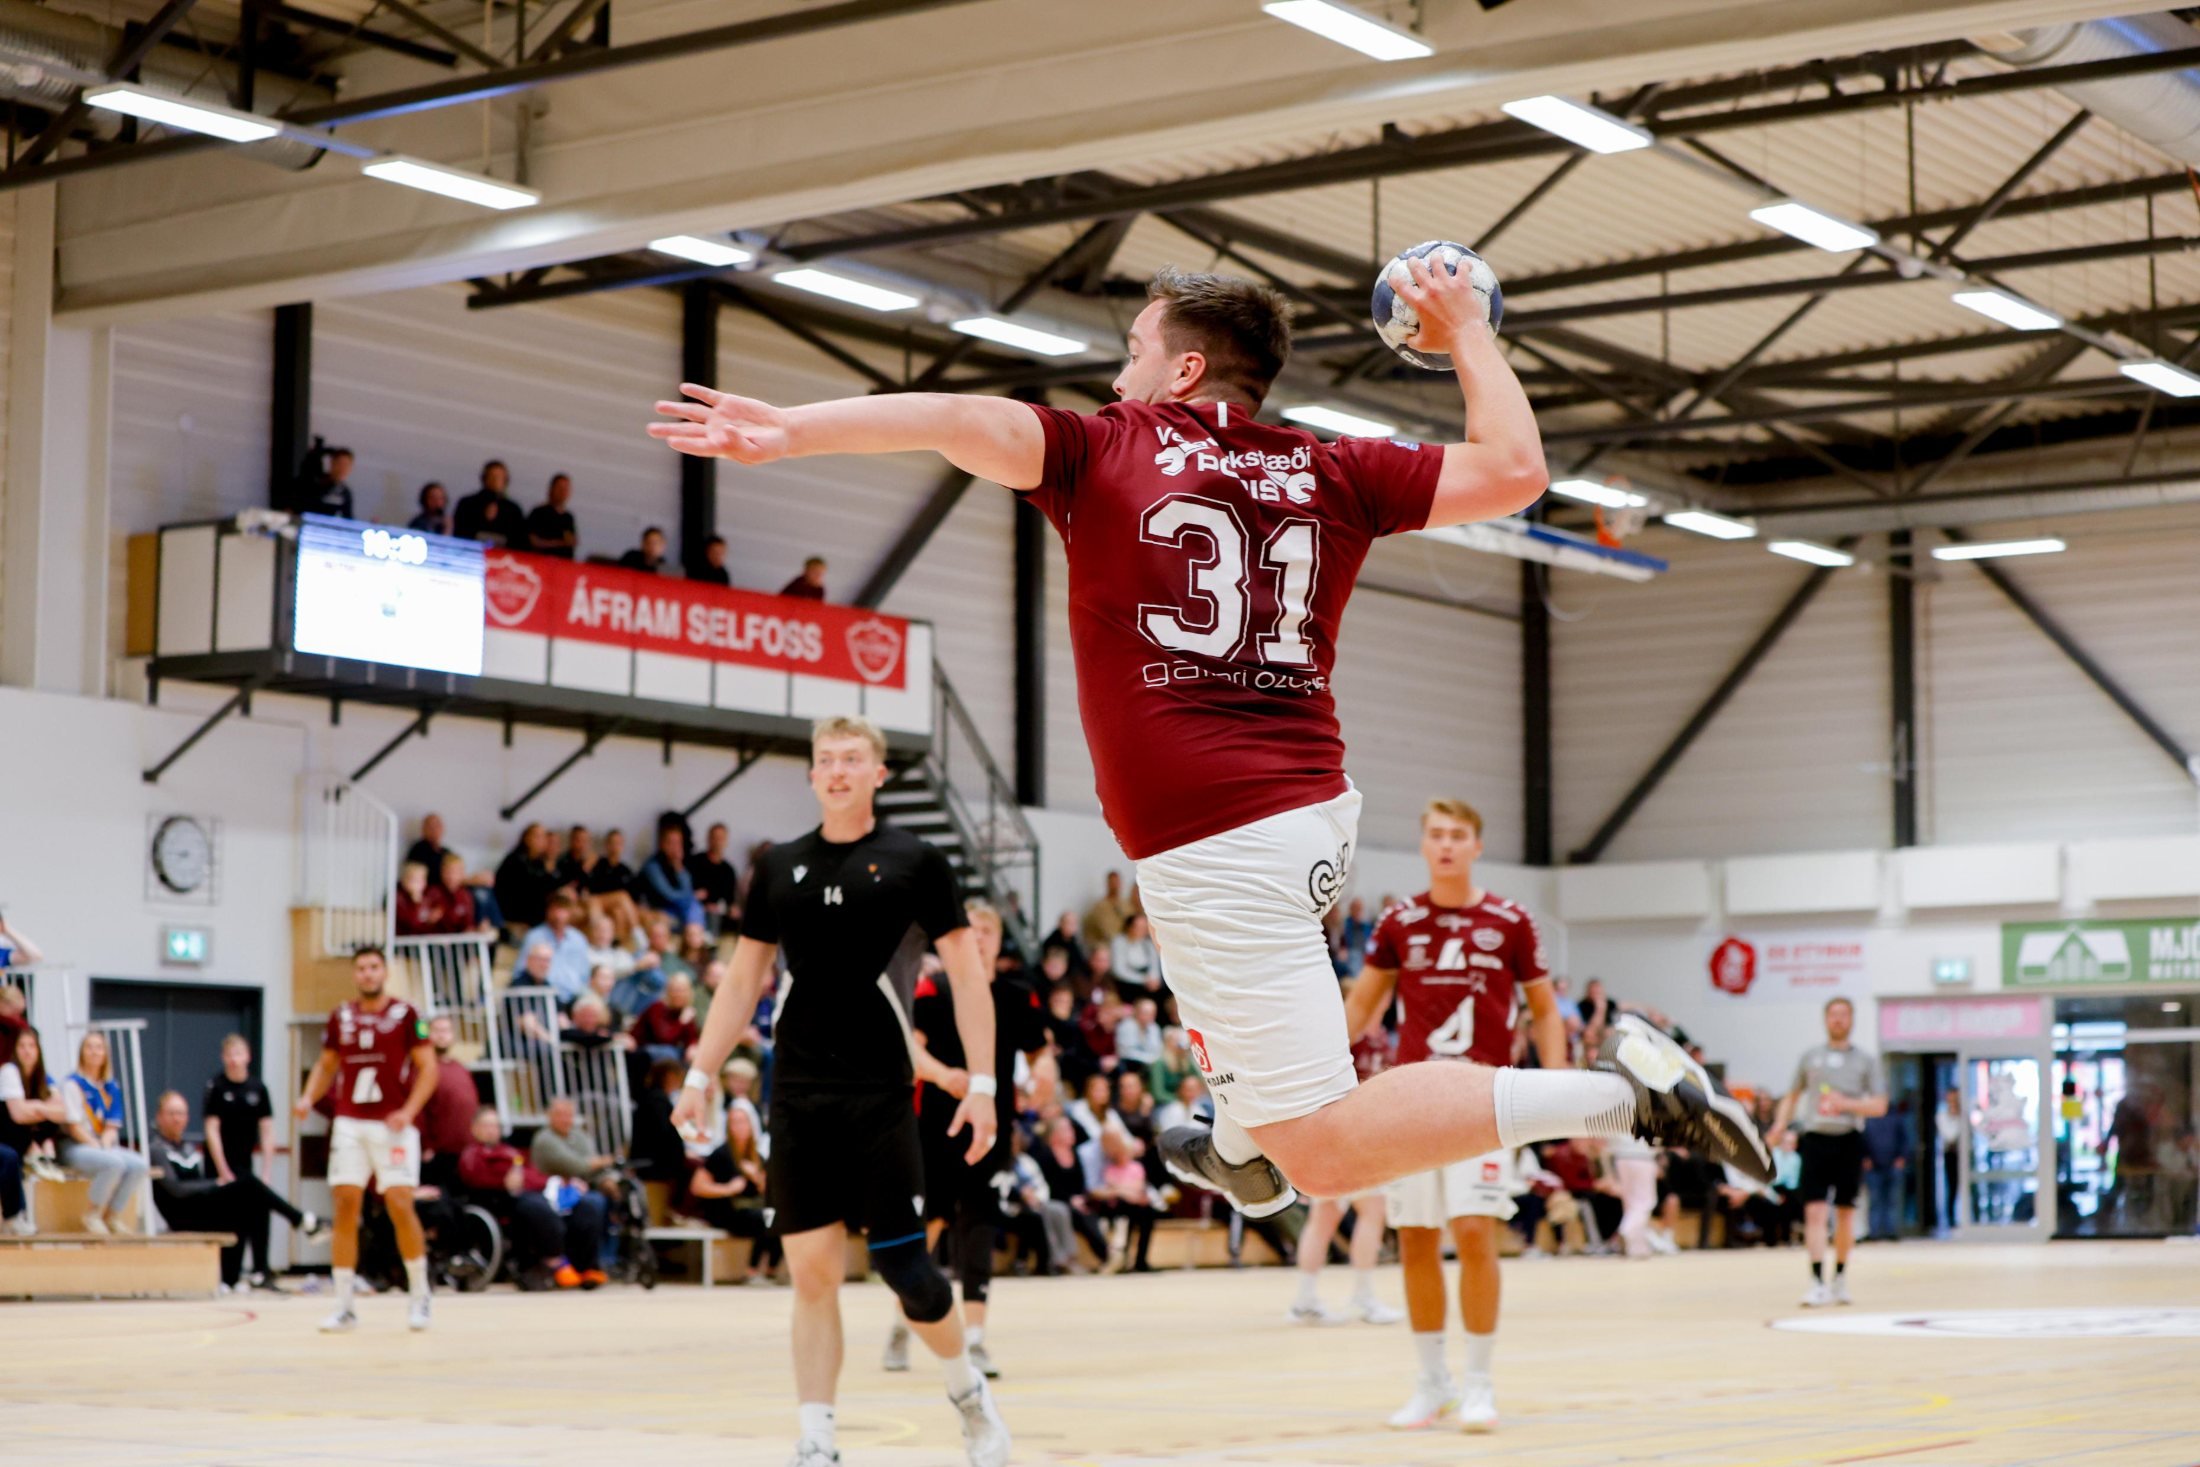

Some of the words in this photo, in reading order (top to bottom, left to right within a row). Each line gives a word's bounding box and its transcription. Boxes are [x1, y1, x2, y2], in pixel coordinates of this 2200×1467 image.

[567, 573, 681, 638] ÁFRAM
[687, 603, 823, 662] SELFOSS
[1137, 492, 1320, 672] 31
[824, 885, 843, 905] 14
